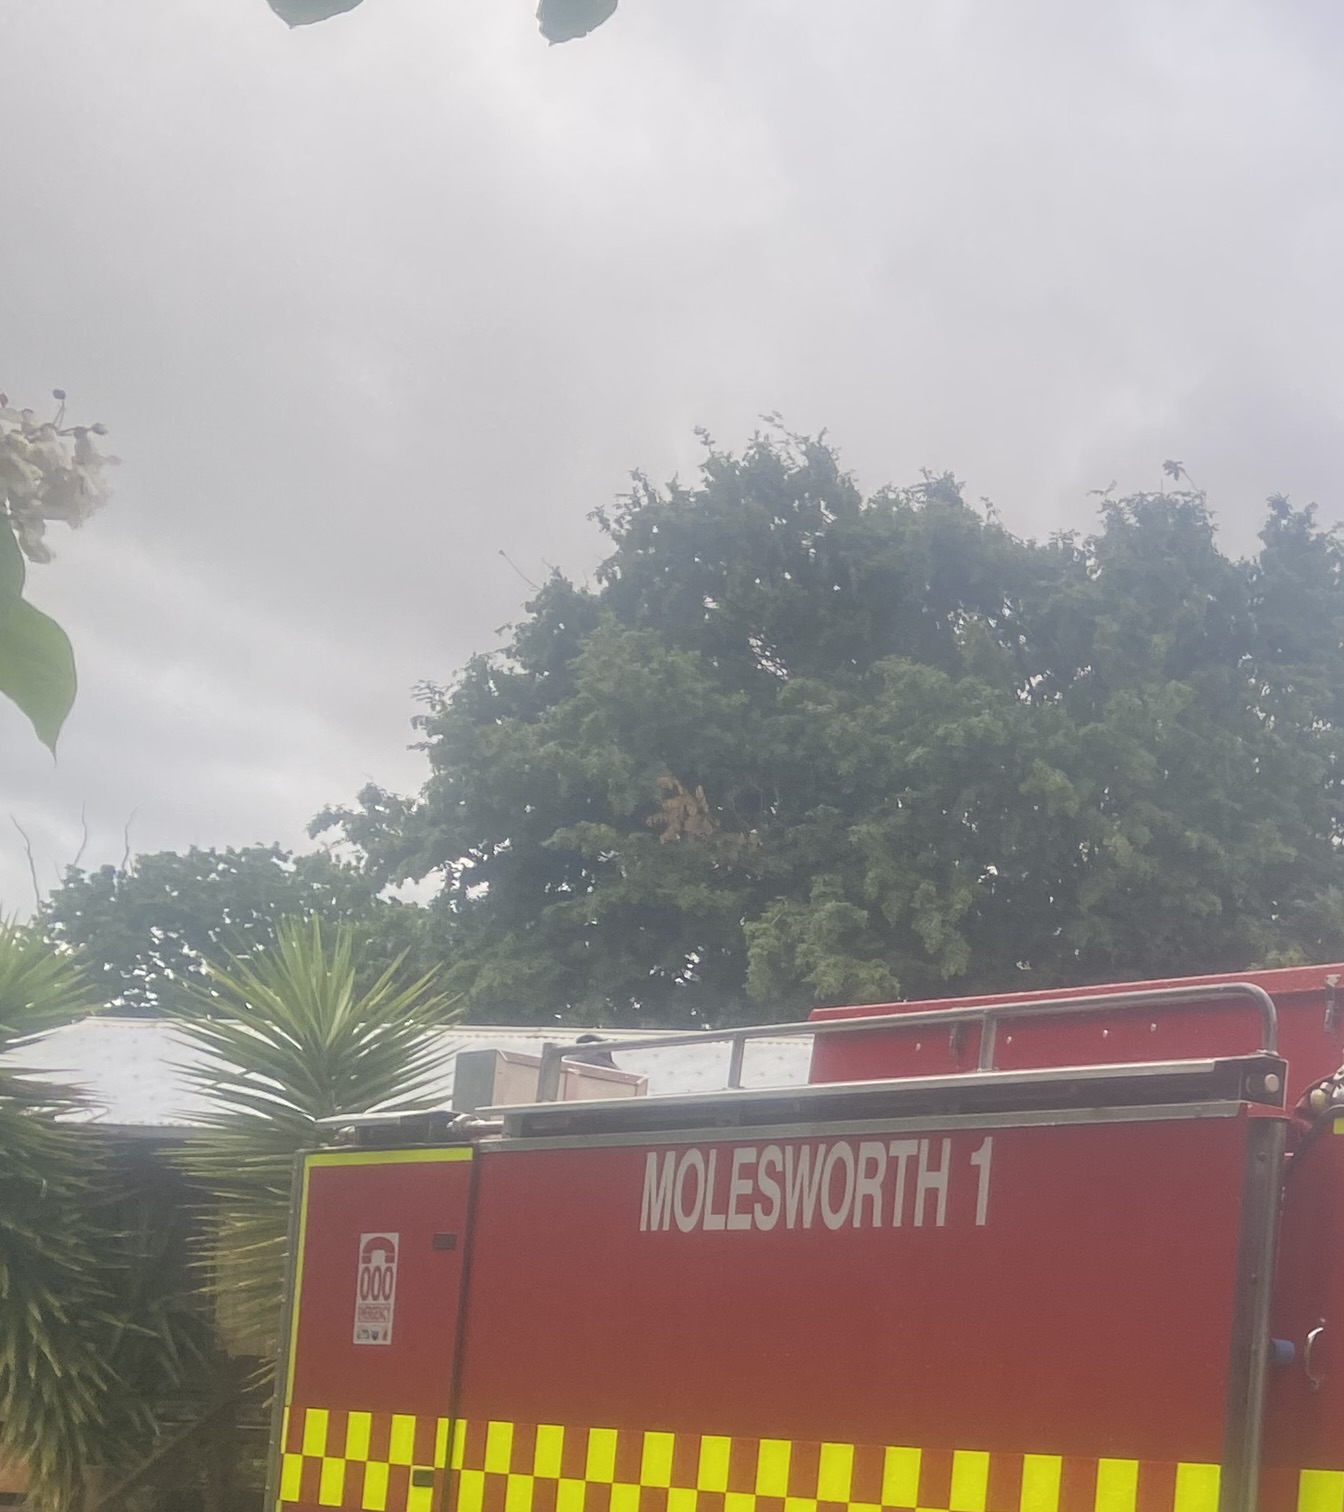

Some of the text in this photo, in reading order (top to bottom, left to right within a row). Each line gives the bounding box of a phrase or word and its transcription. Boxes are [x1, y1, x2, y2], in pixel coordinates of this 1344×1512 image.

[639, 1135, 993, 1233] MOLESWORTH 1
[360, 1264, 394, 1302] 000
